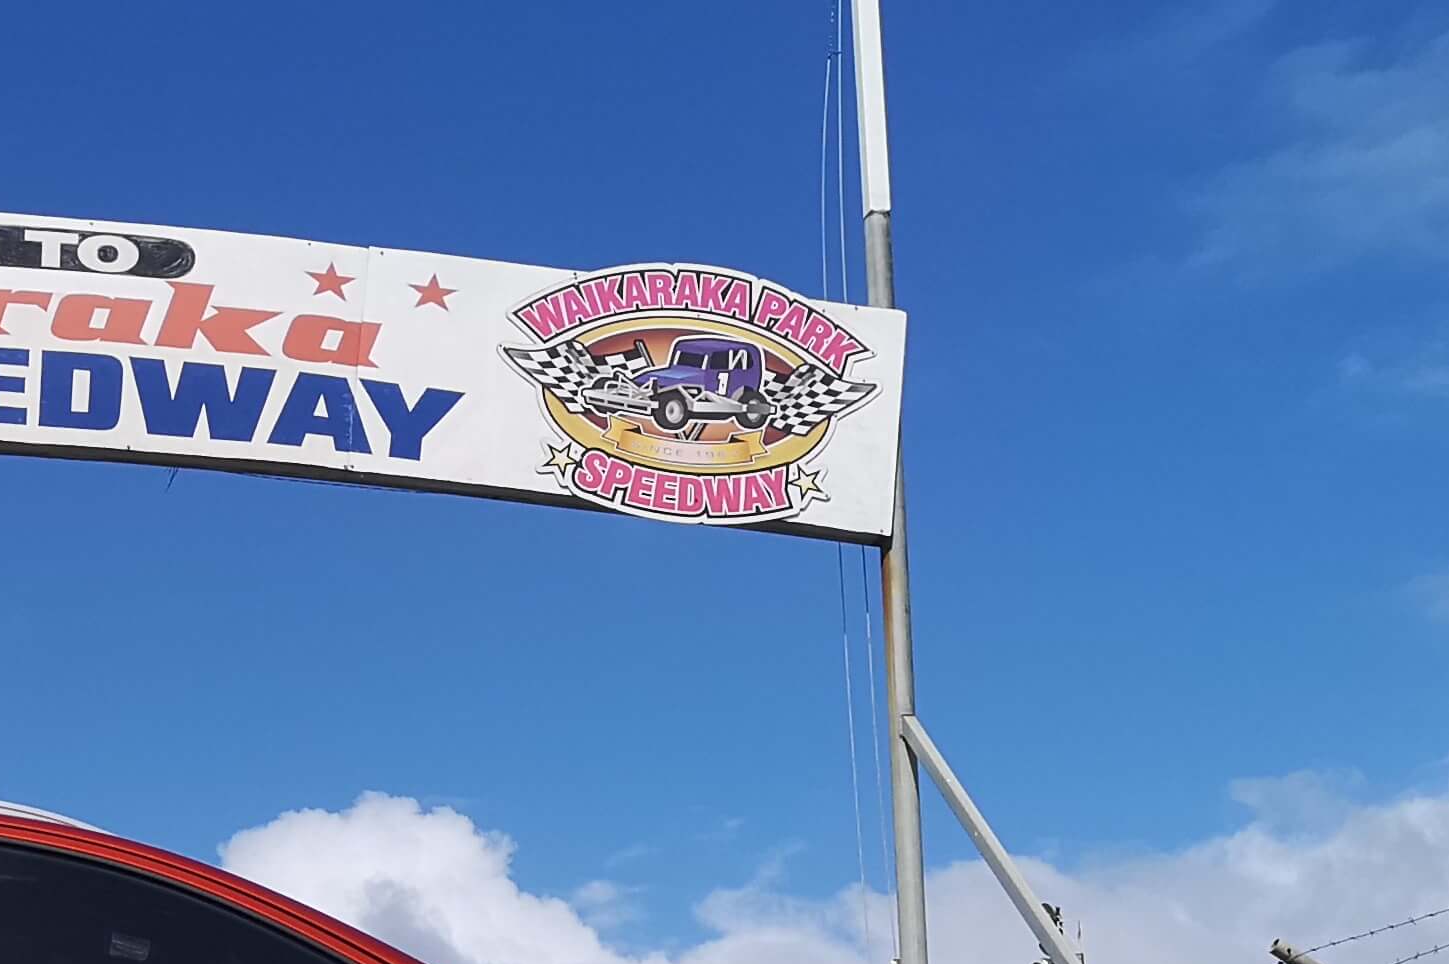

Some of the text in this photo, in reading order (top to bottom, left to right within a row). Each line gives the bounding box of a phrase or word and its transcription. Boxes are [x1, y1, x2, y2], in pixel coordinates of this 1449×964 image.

[24, 228, 140, 273] TO
[516, 270, 864, 370] WAIKARAKA PARK
[575, 453, 789, 515] SPEEDWAY
